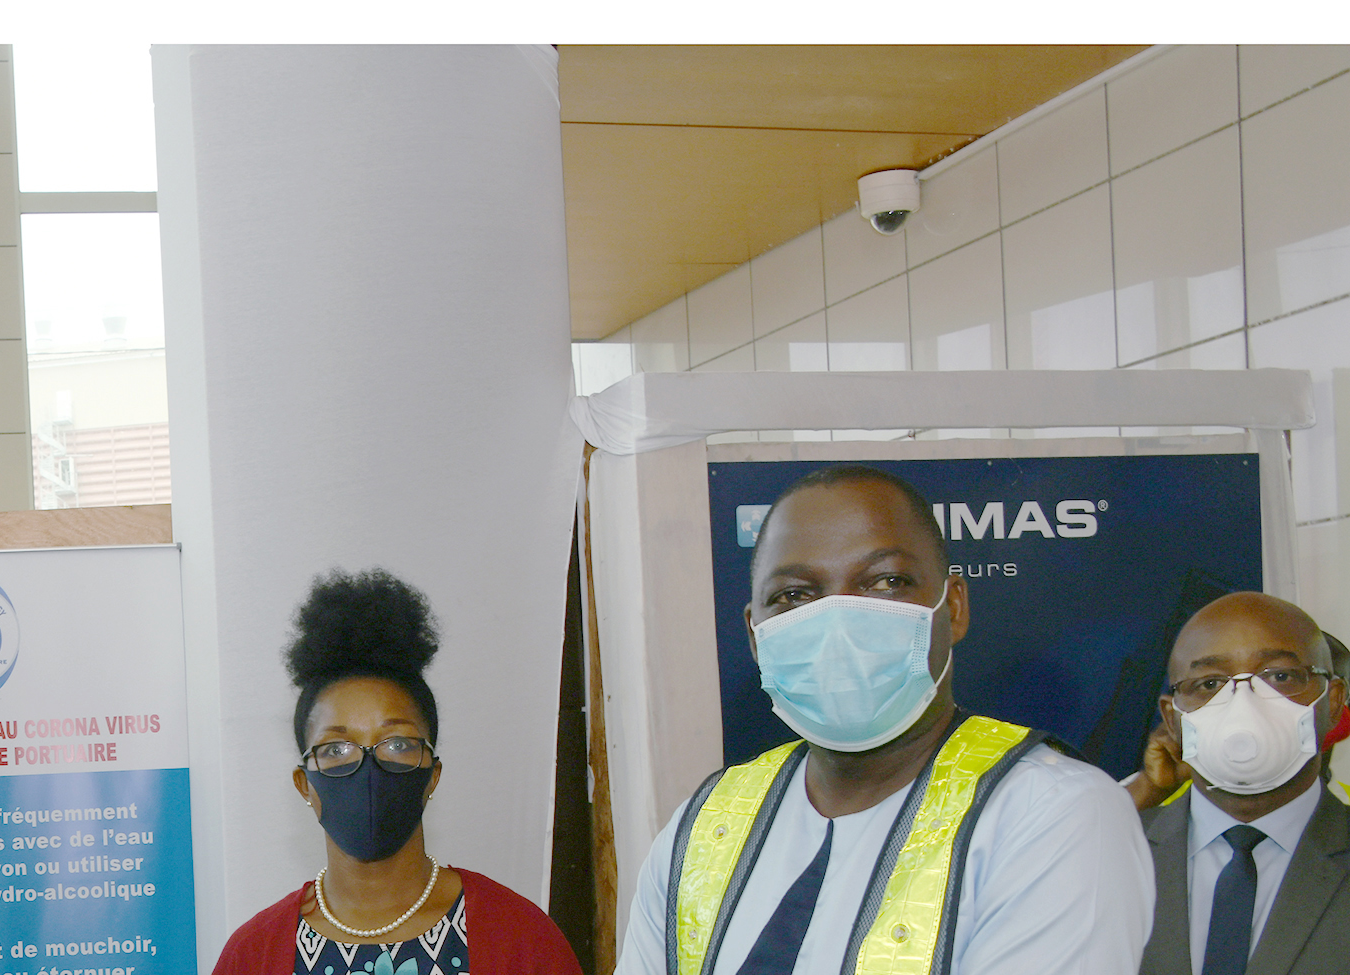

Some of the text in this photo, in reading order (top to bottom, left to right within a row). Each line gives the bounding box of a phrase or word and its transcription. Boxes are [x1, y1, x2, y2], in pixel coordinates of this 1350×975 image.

[948, 562, 1018, 578] eurs
[24, 717, 100, 739] CORONA
[105, 714, 161, 735] VIRUS
[14, 742, 117, 766] PORTUAIRE
[12, 834, 62, 851] avec
[69, 830, 95, 848] de
[102, 828, 154, 846] l'eau
[34, 860, 60, 875] ou
[68, 855, 144, 873] utiliser
[11, 941, 38, 959] de
[45, 935, 157, 957] mouchoir,
